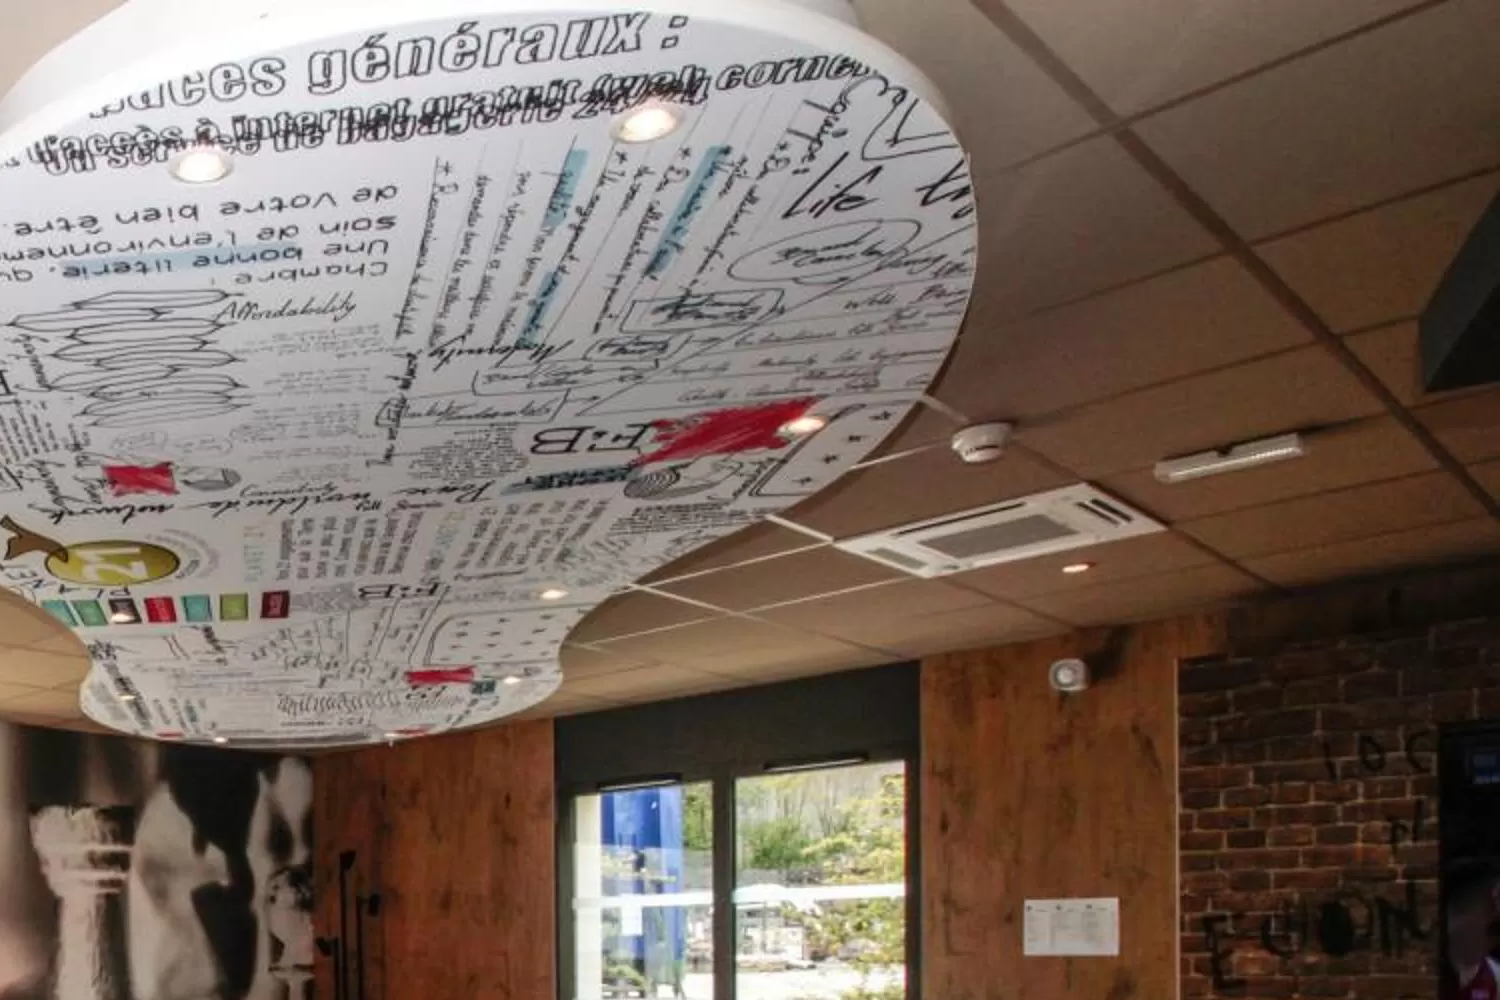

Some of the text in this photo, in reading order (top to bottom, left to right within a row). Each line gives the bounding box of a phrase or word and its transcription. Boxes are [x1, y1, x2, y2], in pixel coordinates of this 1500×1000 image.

[89, 58, 287, 119] aces
[308, 12, 651, 95] généraux
[715, 54, 870, 91] corne
[352, 186, 399, 206] de
[781, 152, 884, 219] Life
[115, 204, 200, 230] bien
[319, 215, 398, 238] soin
[256, 225, 300, 245] de
[191, 246, 302, 270] bonne
[322, 238, 389, 260] Une
[235, 261, 388, 288] Chambre
[216, 290, 357, 323] Affordability
